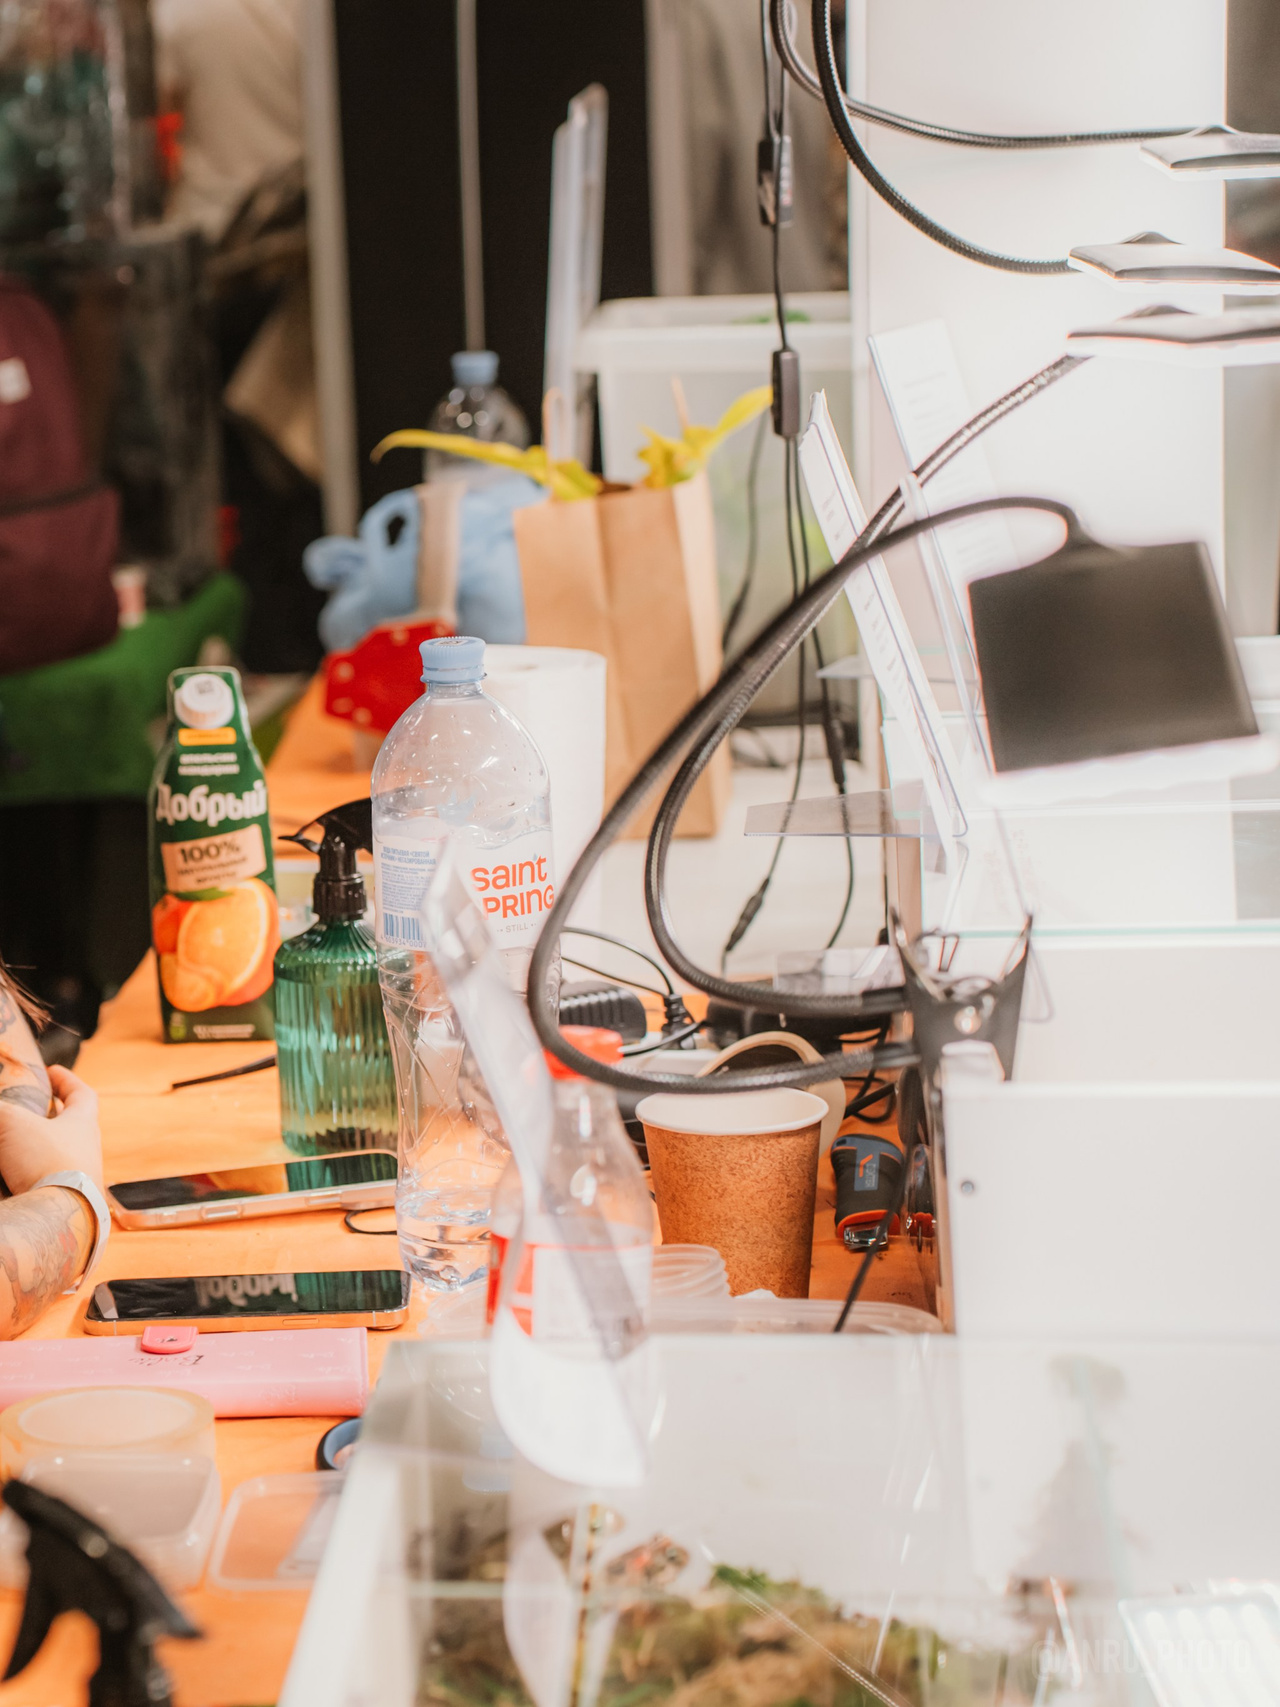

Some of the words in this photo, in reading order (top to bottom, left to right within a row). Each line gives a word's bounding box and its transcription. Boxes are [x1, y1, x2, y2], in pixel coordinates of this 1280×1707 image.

[156, 779, 267, 827] Добрый
[180, 839, 241, 864] 100%
[471, 856, 548, 892] saint
[482, 884, 554, 920] PRING
[505, 922, 529, 933] STILL
